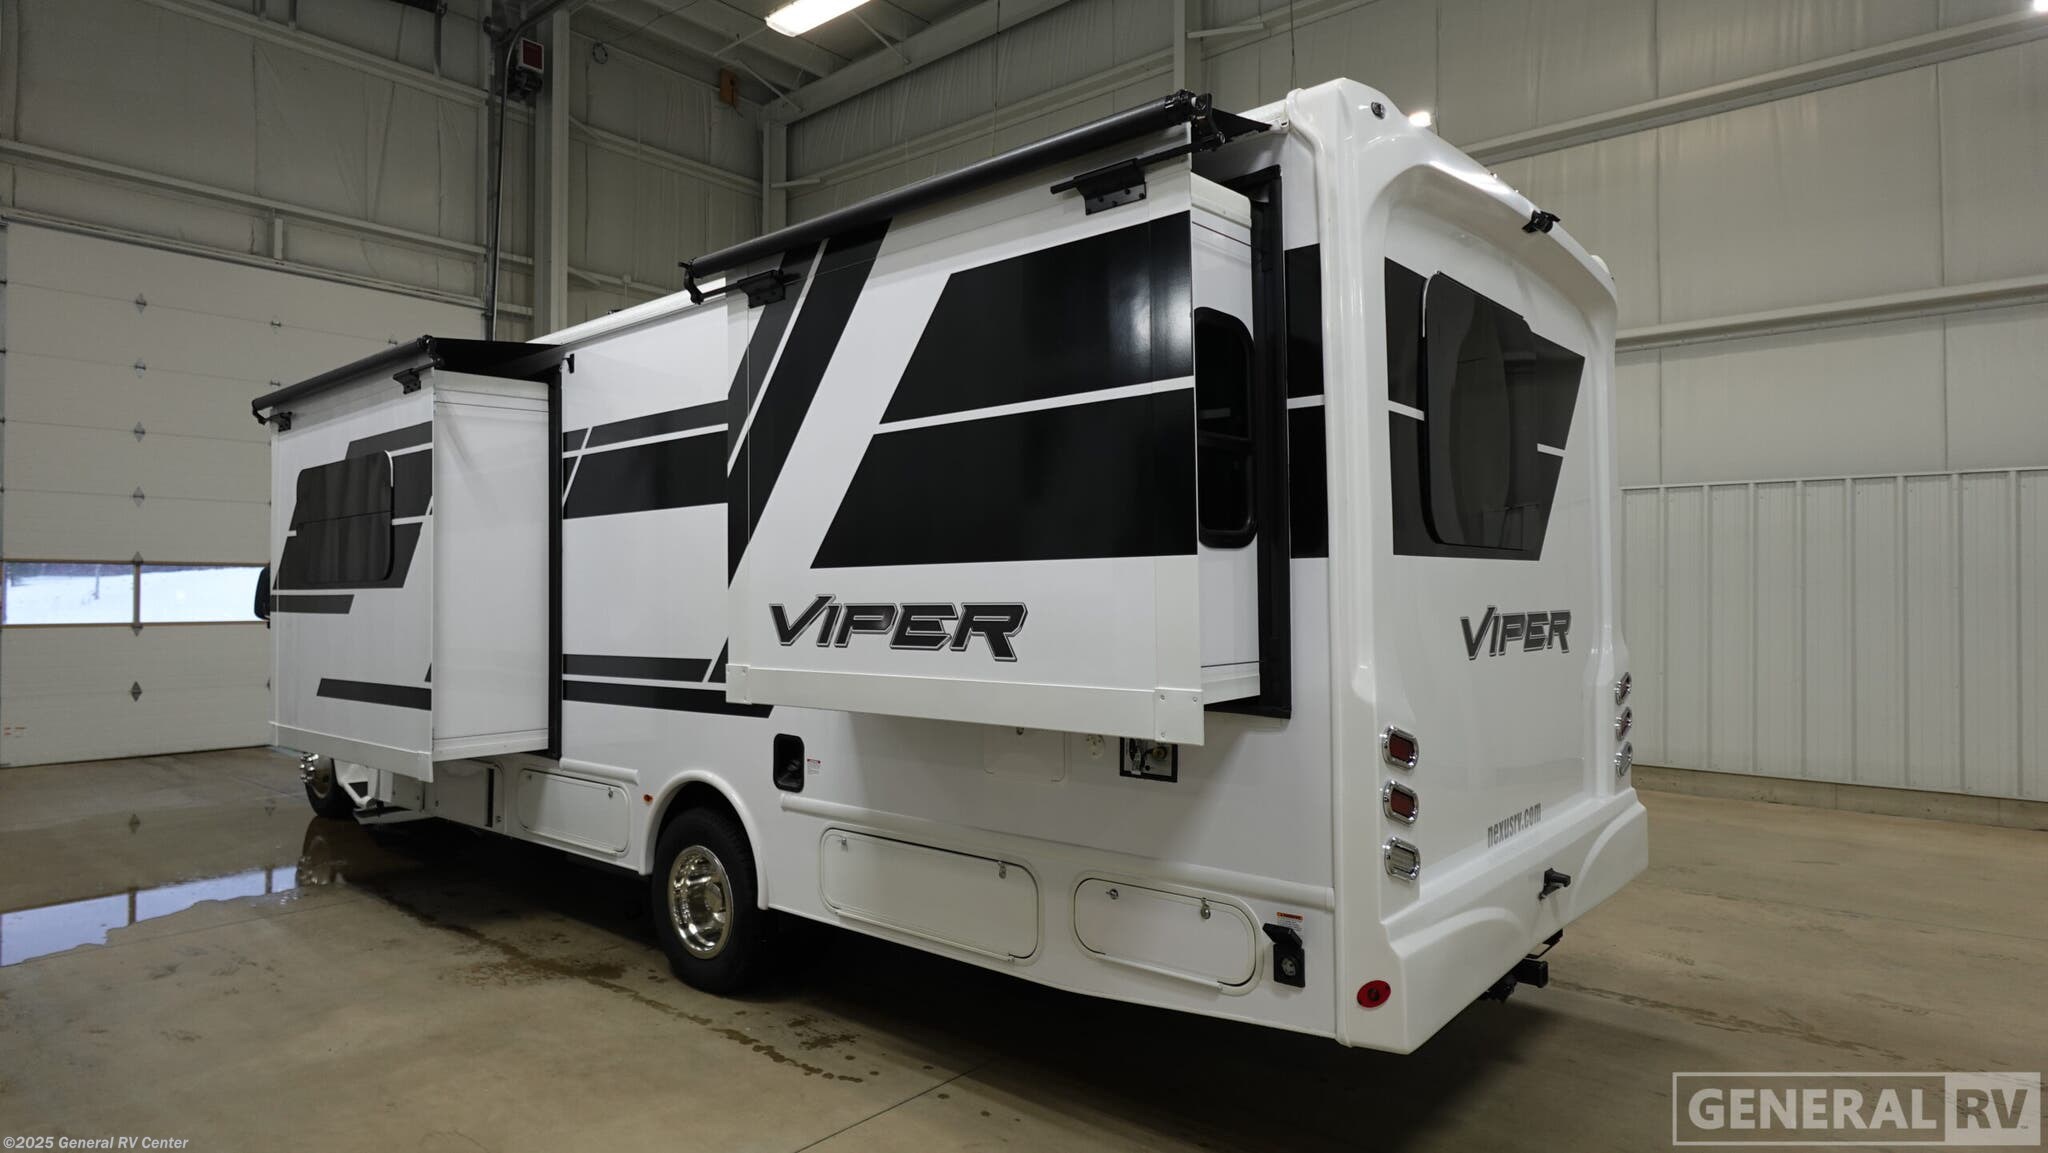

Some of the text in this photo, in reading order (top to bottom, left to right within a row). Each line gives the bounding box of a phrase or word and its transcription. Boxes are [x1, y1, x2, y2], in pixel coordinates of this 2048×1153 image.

[769, 594, 1028, 662] VIPER
[1460, 605, 1571, 661] VIPER
[1488, 803, 1542, 848] nexusrv.com
